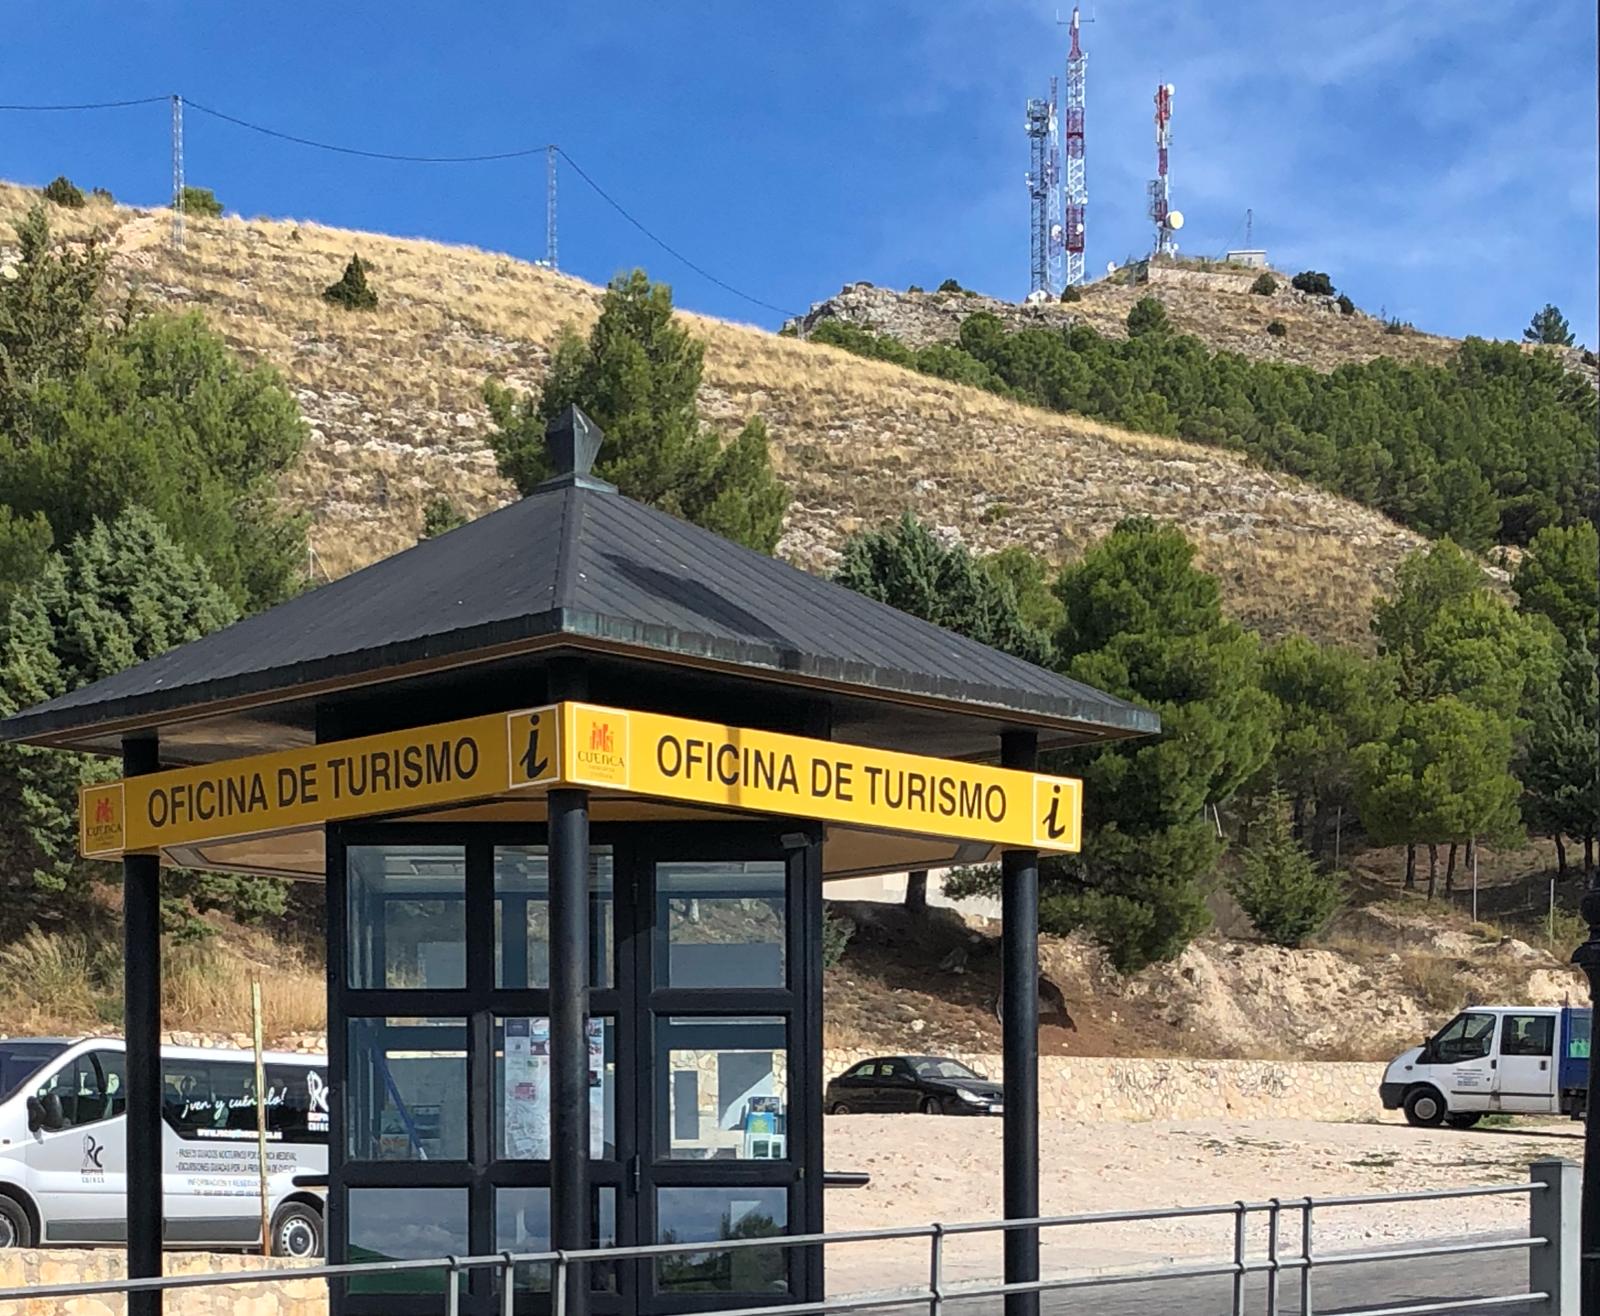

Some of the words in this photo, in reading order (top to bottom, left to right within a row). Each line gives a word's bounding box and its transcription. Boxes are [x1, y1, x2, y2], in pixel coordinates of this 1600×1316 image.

[147, 772, 269, 829] OFICINA
[277, 762, 319, 808] DE
[326, 736, 479, 799] TURISMO
[518, 714, 549, 779] i
[656, 734, 799, 795] OFICINA
[811, 758, 853, 802] DE
[864, 766, 1008, 824] TURISMO
[1041, 784, 1066, 840] i
